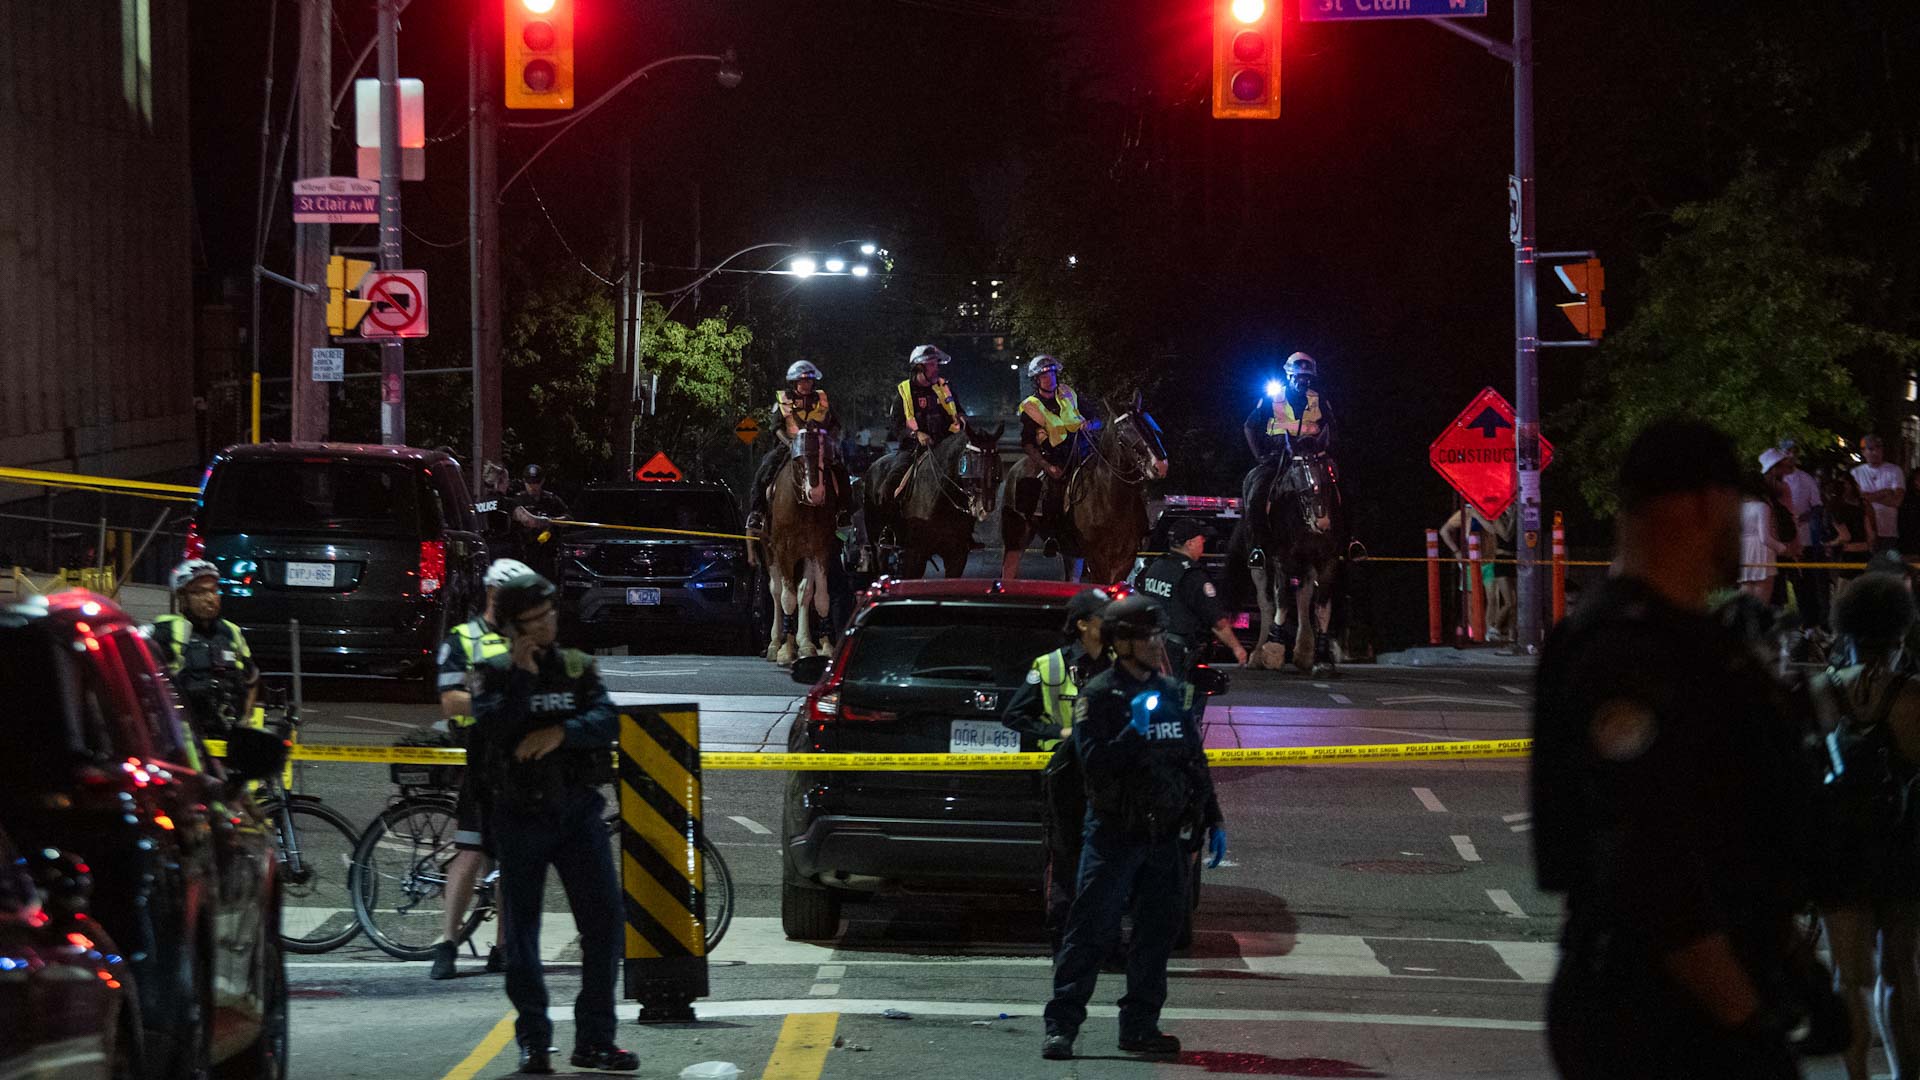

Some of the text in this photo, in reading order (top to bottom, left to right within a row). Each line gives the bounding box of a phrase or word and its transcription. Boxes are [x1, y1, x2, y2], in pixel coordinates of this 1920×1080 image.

[1356, 0, 1411, 11] Clair
[300, 196, 375, 211] St Clair Av W
[1440, 448, 1517, 464] CONSTRUCT
[475, 500, 498, 513] POLICE
[1145, 578, 1172, 598] POLICE
[530, 692, 576, 713] FIRE
[1146, 721, 1184, 741] FIRE
